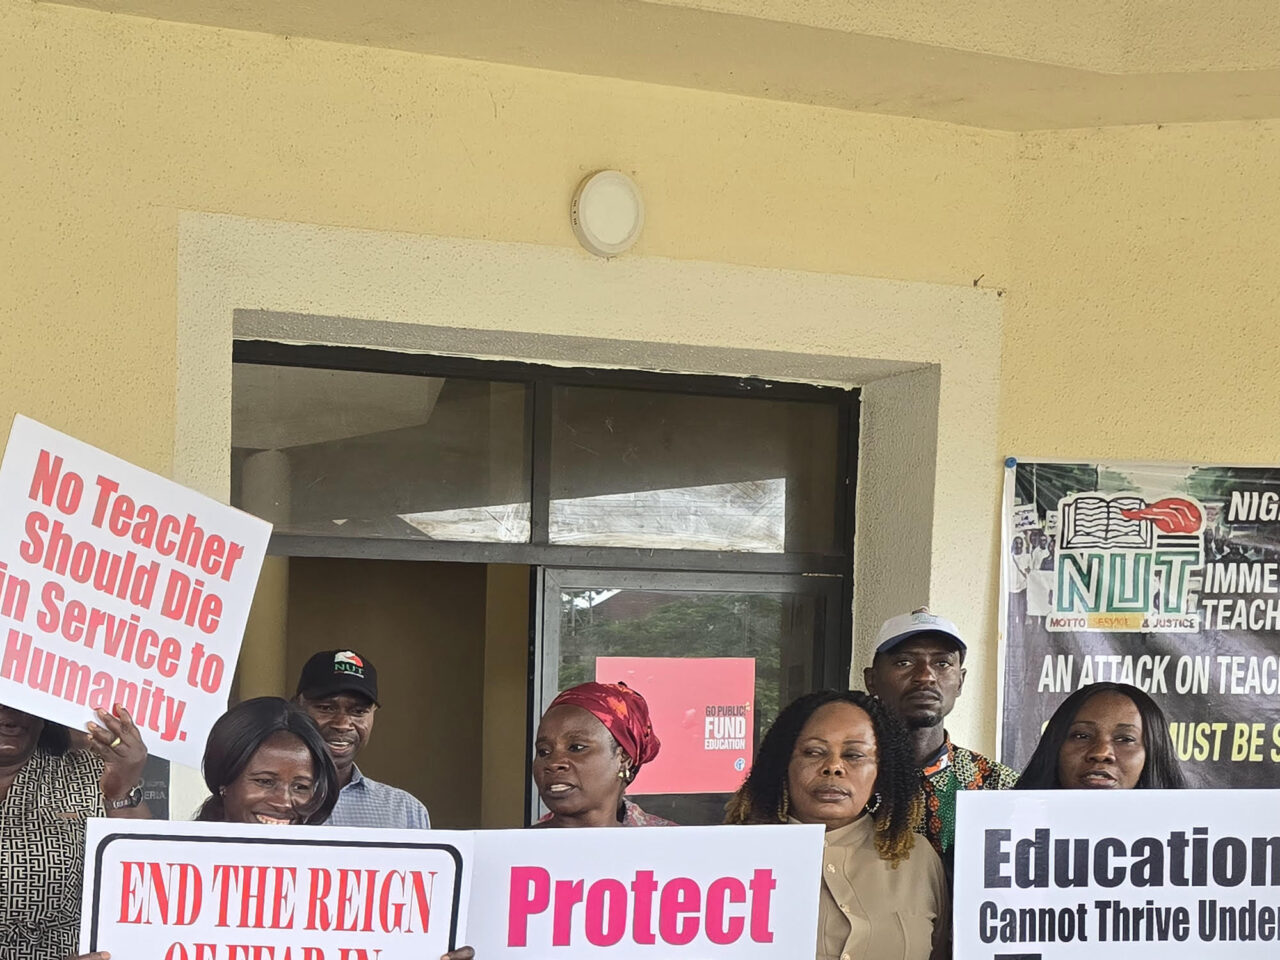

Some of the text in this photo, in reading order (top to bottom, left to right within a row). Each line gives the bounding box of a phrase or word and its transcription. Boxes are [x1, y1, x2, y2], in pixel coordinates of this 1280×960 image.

[28, 449, 245, 582] No Teacher
[1228, 491, 1280, 521] NIG
[20, 511, 223, 634] Should Die
[1056, 551, 1200, 613] NUT
[37, 581, 181, 677] Service
[187, 642, 224, 694] to
[1152, 617, 1195, 629] JUSTICE
[0, 628, 187, 741] Humanity.
[334, 663, 364, 675] NUT
[1037, 654, 1280, 695] AN ATTACK ON TEAC
[704, 716, 746, 739] FUND
[705, 705, 716, 717] GO
[704, 738, 746, 750] EDUCATION
[1231, 722, 1266, 762] BE
[144, 790, 167, 800] ERIA
[983, 826, 1280, 889] Education
[116, 861, 438, 934] END THE REIGN
[507, 866, 777, 948] Protect
[979, 899, 1280, 944] Cannot Thrive Unde
